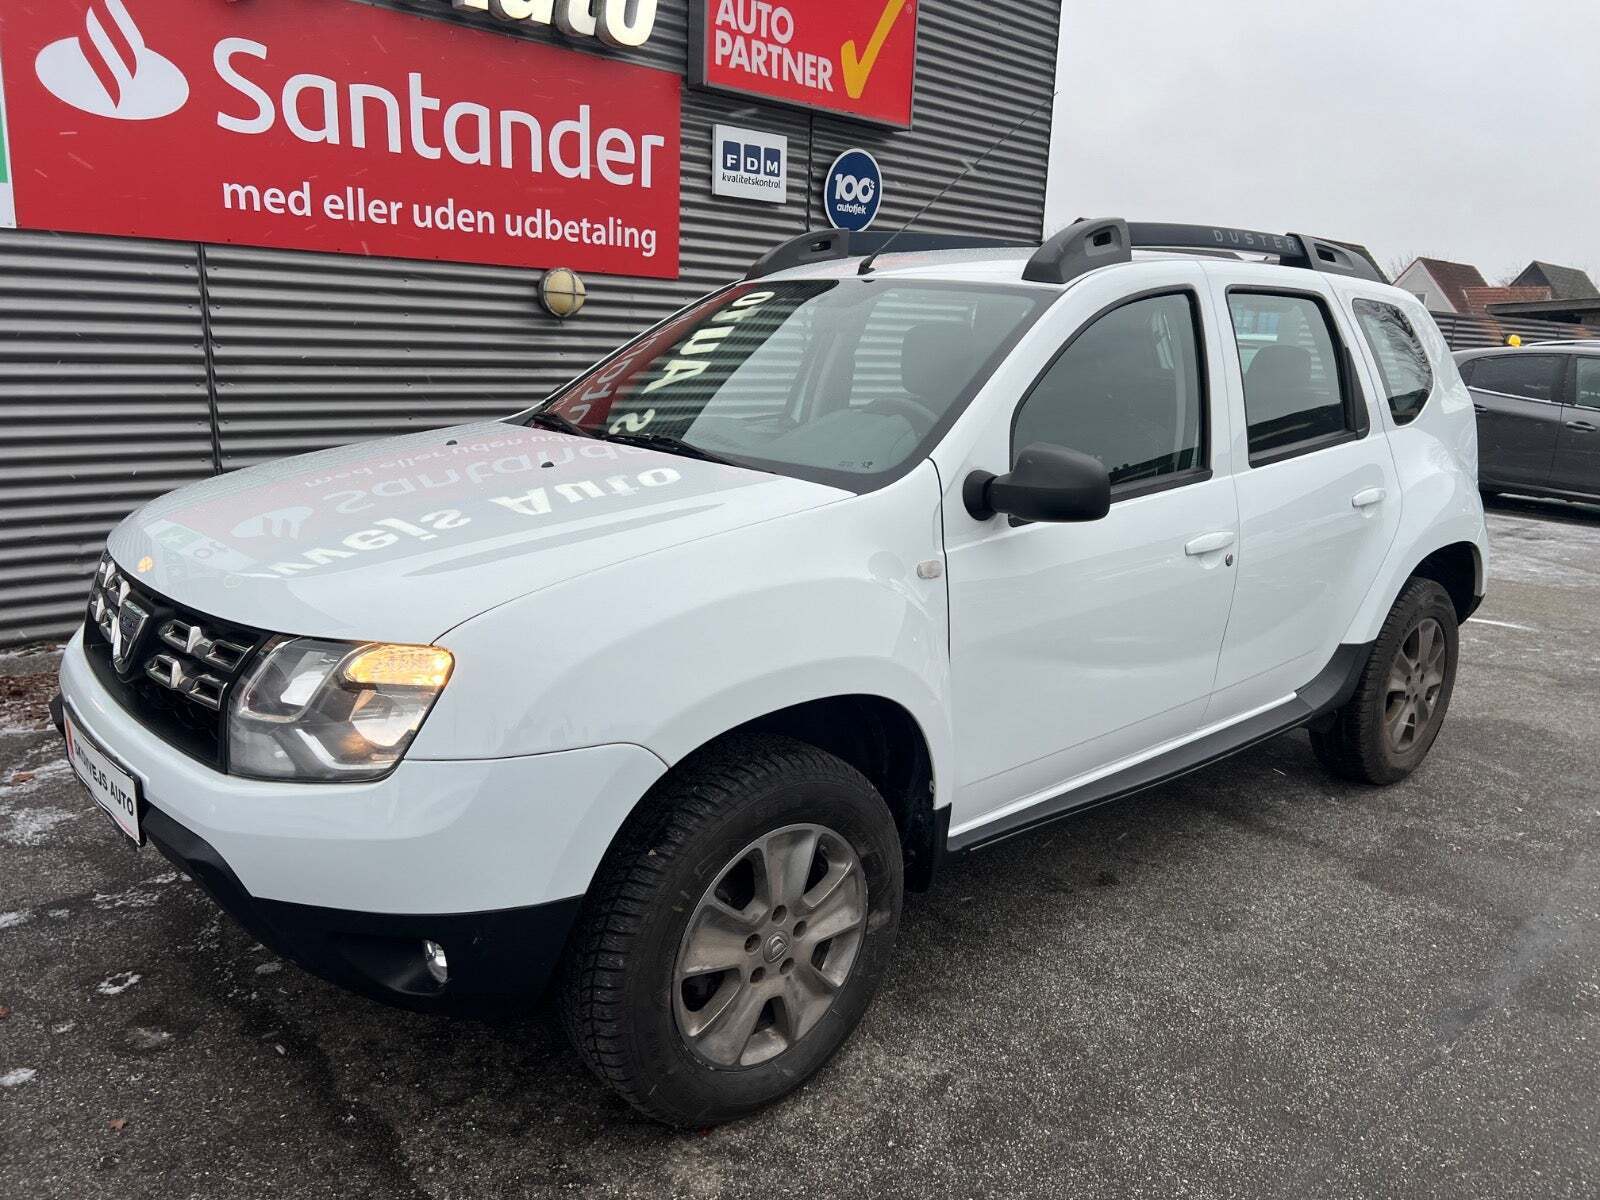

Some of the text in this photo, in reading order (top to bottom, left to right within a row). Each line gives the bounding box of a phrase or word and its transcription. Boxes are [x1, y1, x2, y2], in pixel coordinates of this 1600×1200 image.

[715, 0, 794, 44] AUTO
[715, 29, 834, 92] PARTNER
[213, 37, 664, 189] Santander
[722, 172, 781, 189] kvalitetskontrol
[726, 153, 779, 174] FDM
[222, 182, 657, 258] med eller uden udbetaling
[1213, 229, 1297, 251] DUSTER
[110, 781, 134, 817] AUTO
